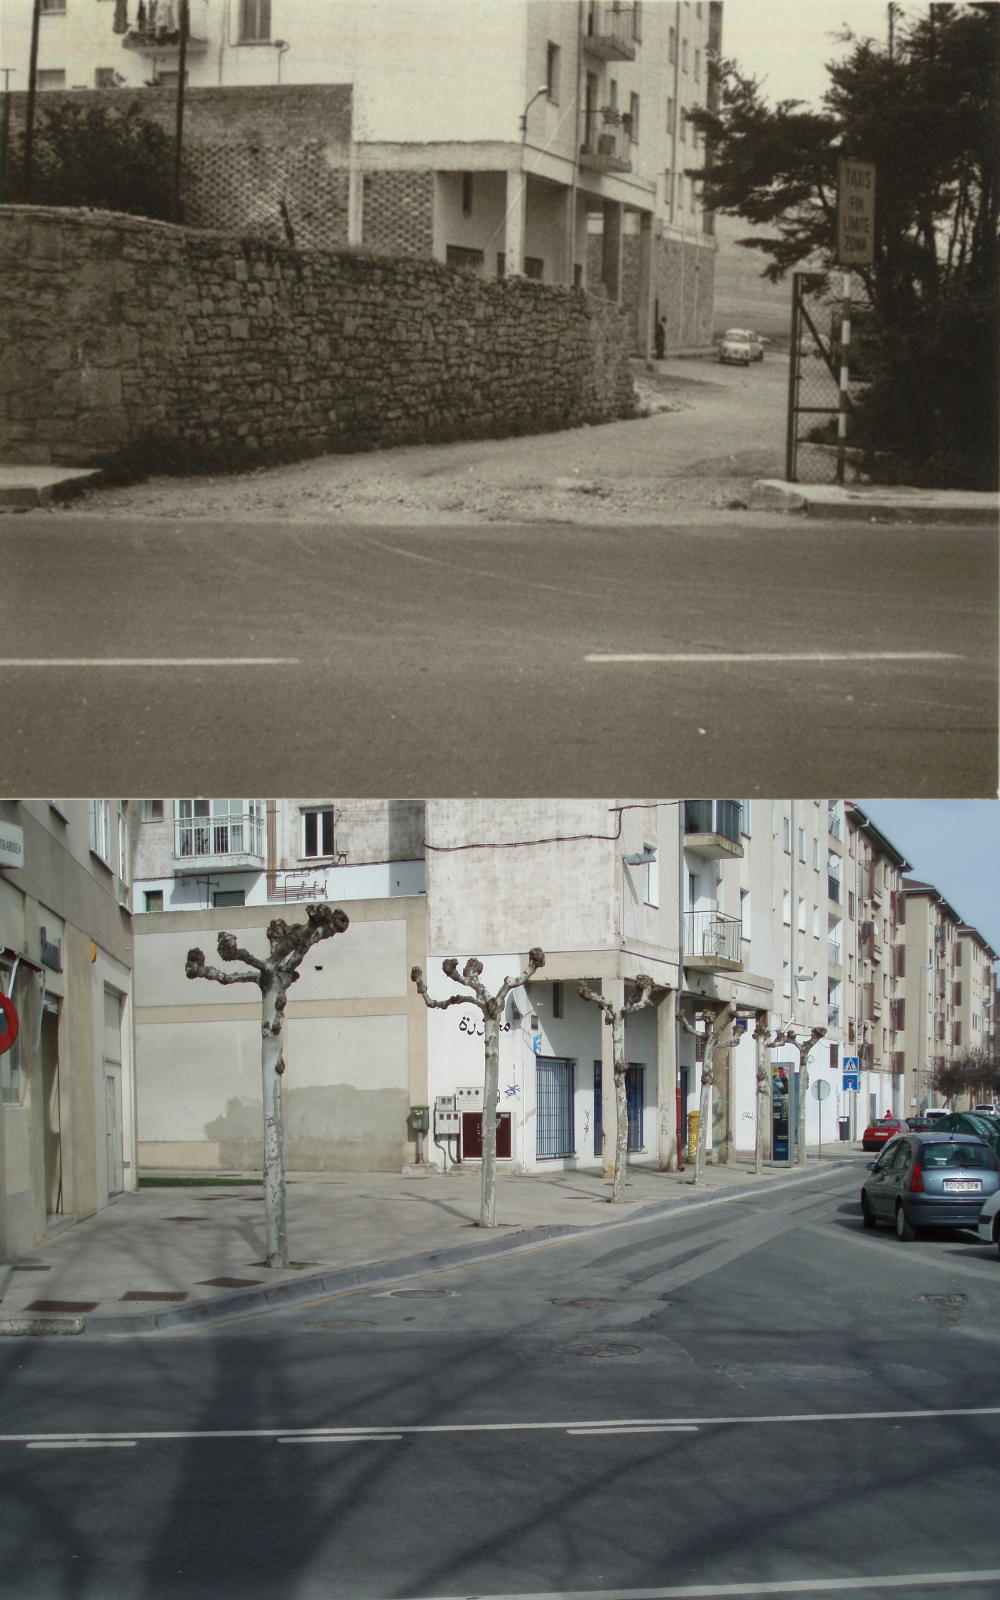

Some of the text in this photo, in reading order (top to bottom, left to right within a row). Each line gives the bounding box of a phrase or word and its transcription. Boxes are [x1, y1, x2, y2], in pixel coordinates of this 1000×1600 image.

[846, 167, 871, 189] TAXIS
[849, 196, 864, 212] FIN
[843, 214, 870, 234] LIMITE
[844, 235, 867, 251] ZONA
